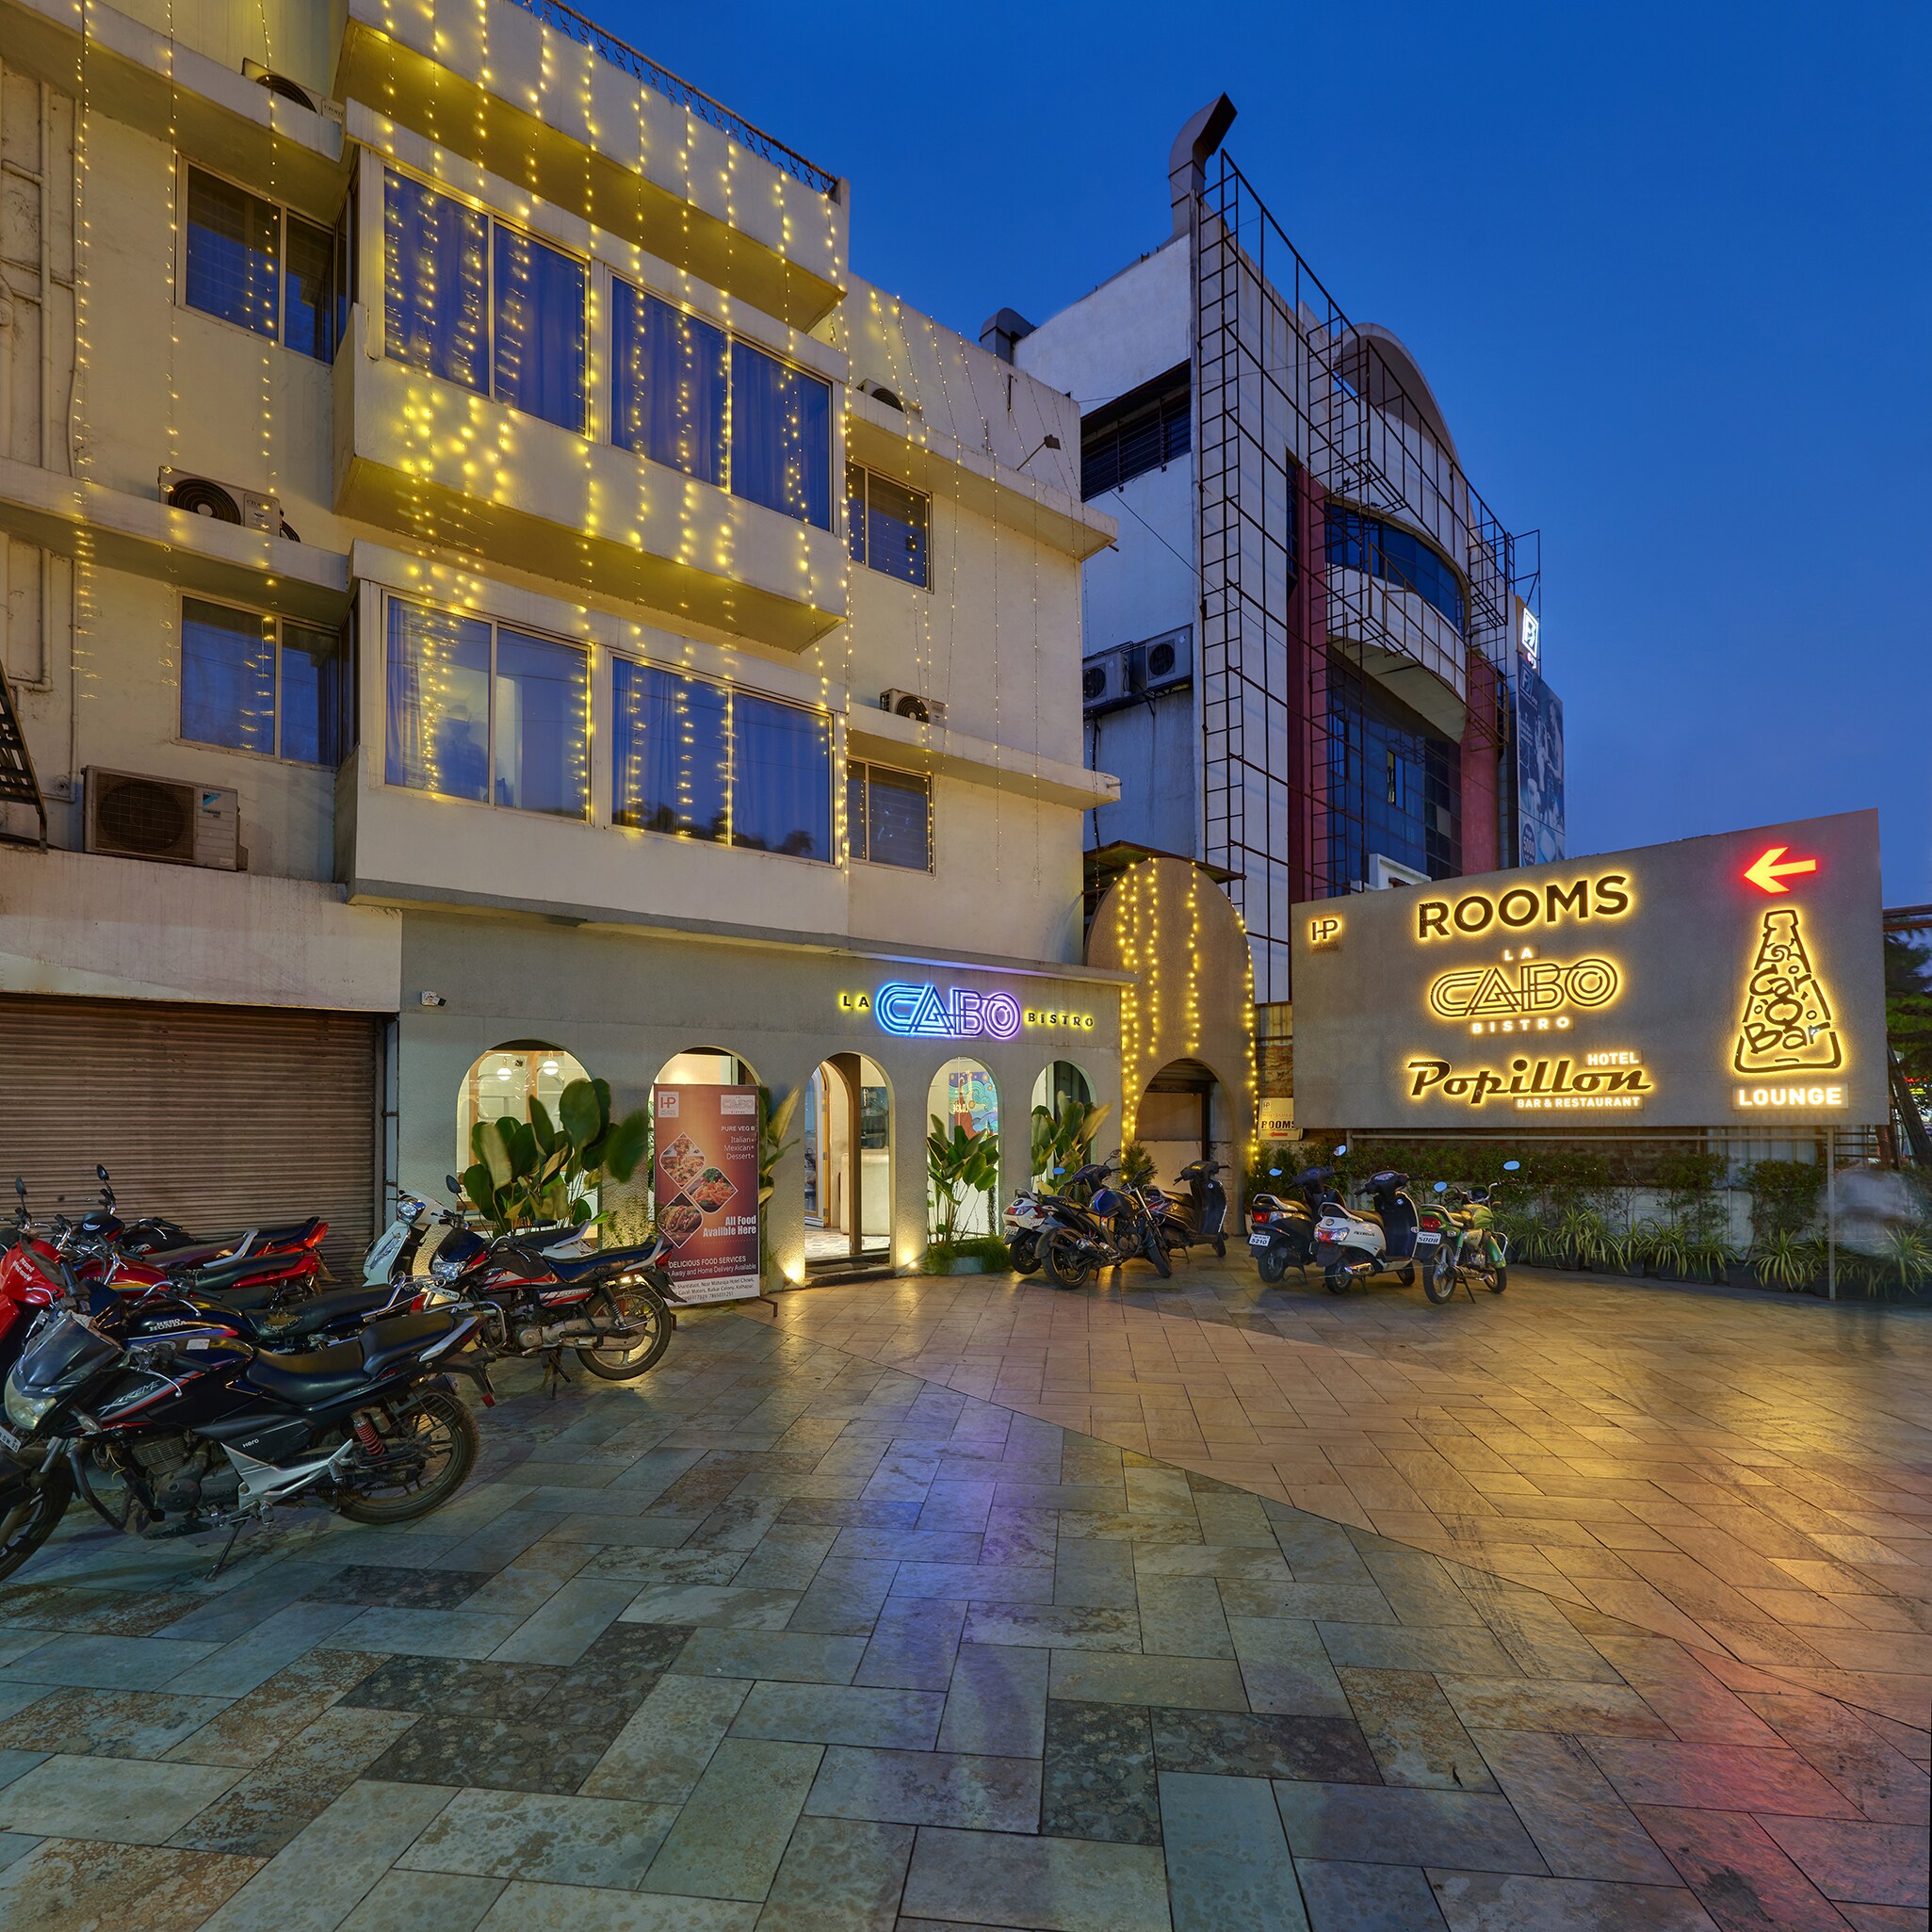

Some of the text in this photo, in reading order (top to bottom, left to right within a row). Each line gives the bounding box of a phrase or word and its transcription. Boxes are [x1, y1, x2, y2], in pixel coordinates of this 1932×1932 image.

[1419, 875, 1629, 938] ROOMS
[1311, 919, 1339, 941] HP
[1504, 948, 1533, 961] LA
[1430, 958, 1618, 1017] CABO
[842, 982, 1094, 1039] LA CABO BISTRO
[1472, 1016, 1570, 1033] BISTRO
[1744, 1021, 1831, 1054] Bar
[1587, 1052, 1639, 1065] HOTEL
[660, 1096, 676, 1109] HP
[1518, 1096, 1640, 1108] BAR & RESTAURANT
[1739, 1087, 1842, 1106] LOUNGE
[725, 1215, 756, 1226] All Food
[703, 1226, 756, 1237] Availble Here
[719, 1256, 747, 1264] SERVICES
[713, 1265, 734, 1274] Delivery
[149, 1321, 187, 1332] HONDA
[156, 1318, 181, 1326] HERO
